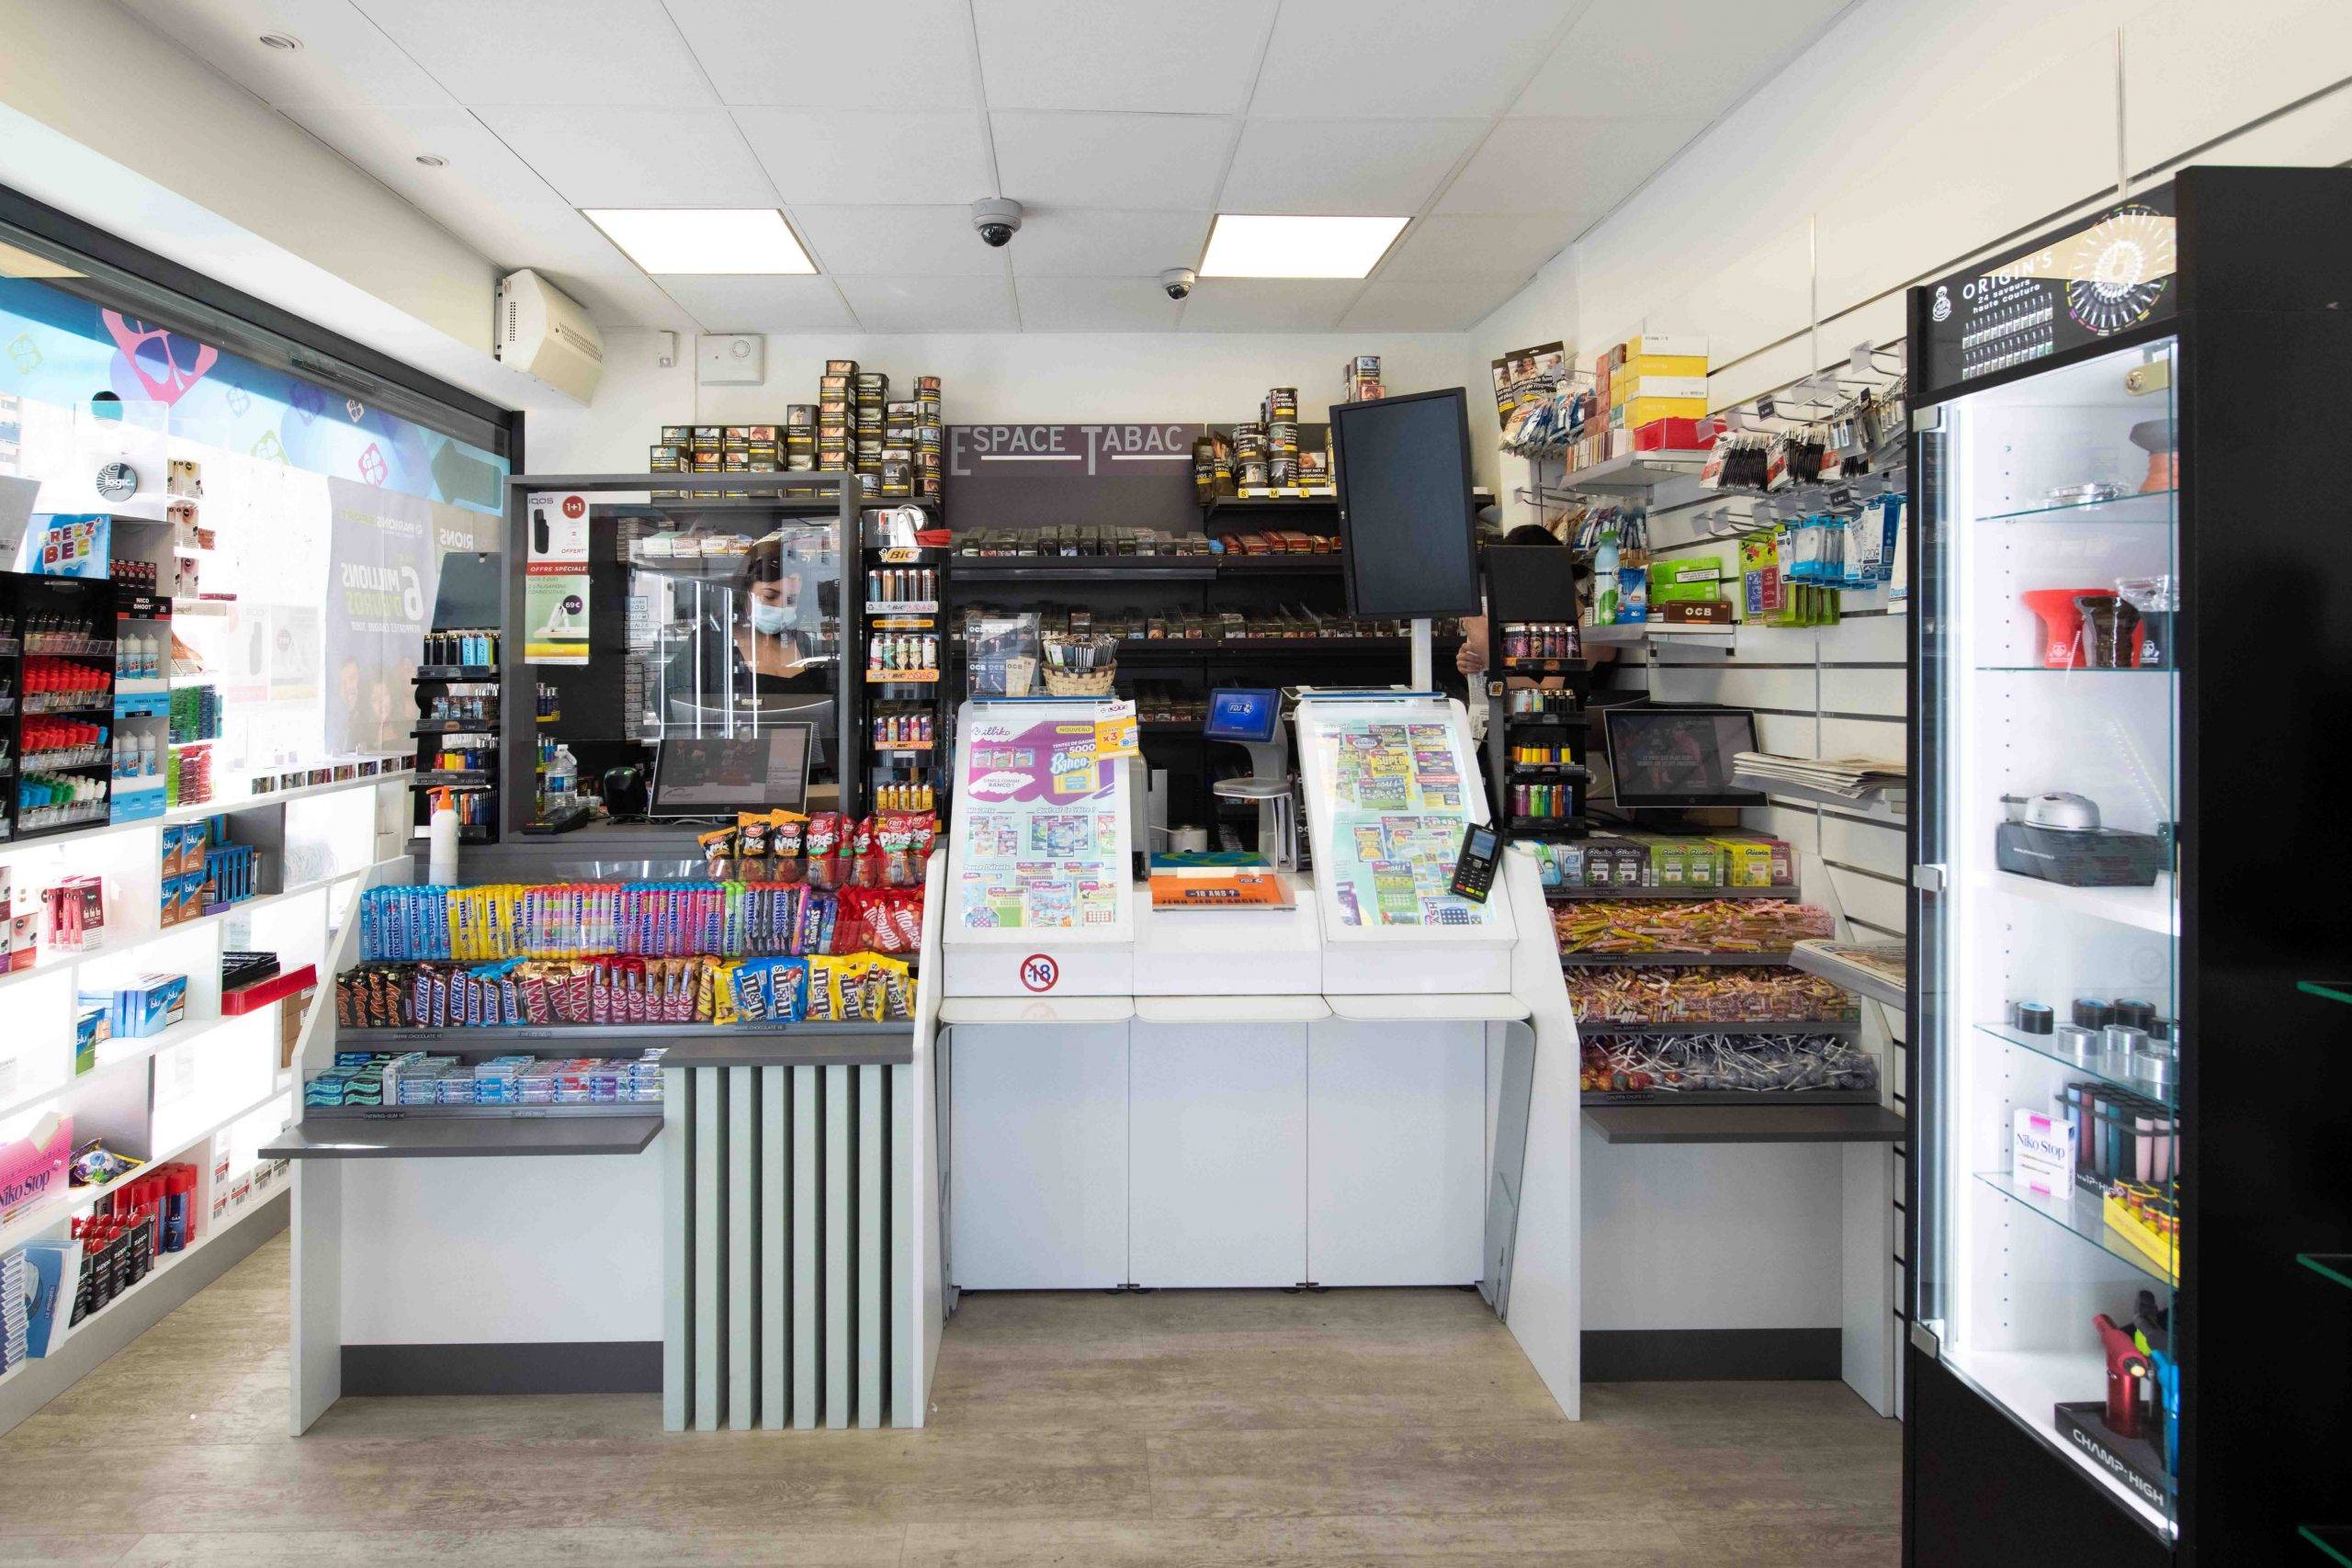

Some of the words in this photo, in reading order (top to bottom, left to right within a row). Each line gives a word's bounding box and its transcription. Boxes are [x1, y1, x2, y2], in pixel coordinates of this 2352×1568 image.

[1962, 251, 2052, 299] ORIGIN'S
[1973, 299, 2000, 314] haute
[2001, 283, 2041, 305] couture
[1977, 294, 1990, 304] 24
[1992, 278, 2031, 299] saveurs
[951, 426, 1066, 476] ESPACE
[1080, 425, 1183, 476] TABAC
[528, 497, 554, 505] IQOS
[566, 502, 582, 512] 1+1
[1685, 607, 1713, 616] OCB
[1051, 752, 1090, 774] Banco
[187, 835, 198, 844] blu
[1588, 848, 1612, 857] Ricola
[1615, 848, 1641, 857] Ricola
[1661, 848, 1685, 857] Ricola
[1690, 848, 1713, 857] Ricola
[1746, 848, 1770, 856] Ricola
[185, 884, 195, 893] blu
[469, 982, 480, 1022] SNICKERS
[485, 984, 499, 1022] SNICKERS
[570, 969, 591, 1023] TWIX
[2017, 1133, 2040, 1151] Niko
[2041, 1139, 2066, 1160] Stop
[24, 1169, 51, 1196] Stop
[96, 1258, 111, 1272] zippo
[2073, 1427, 2165, 1507] CHAMP-HIGH
